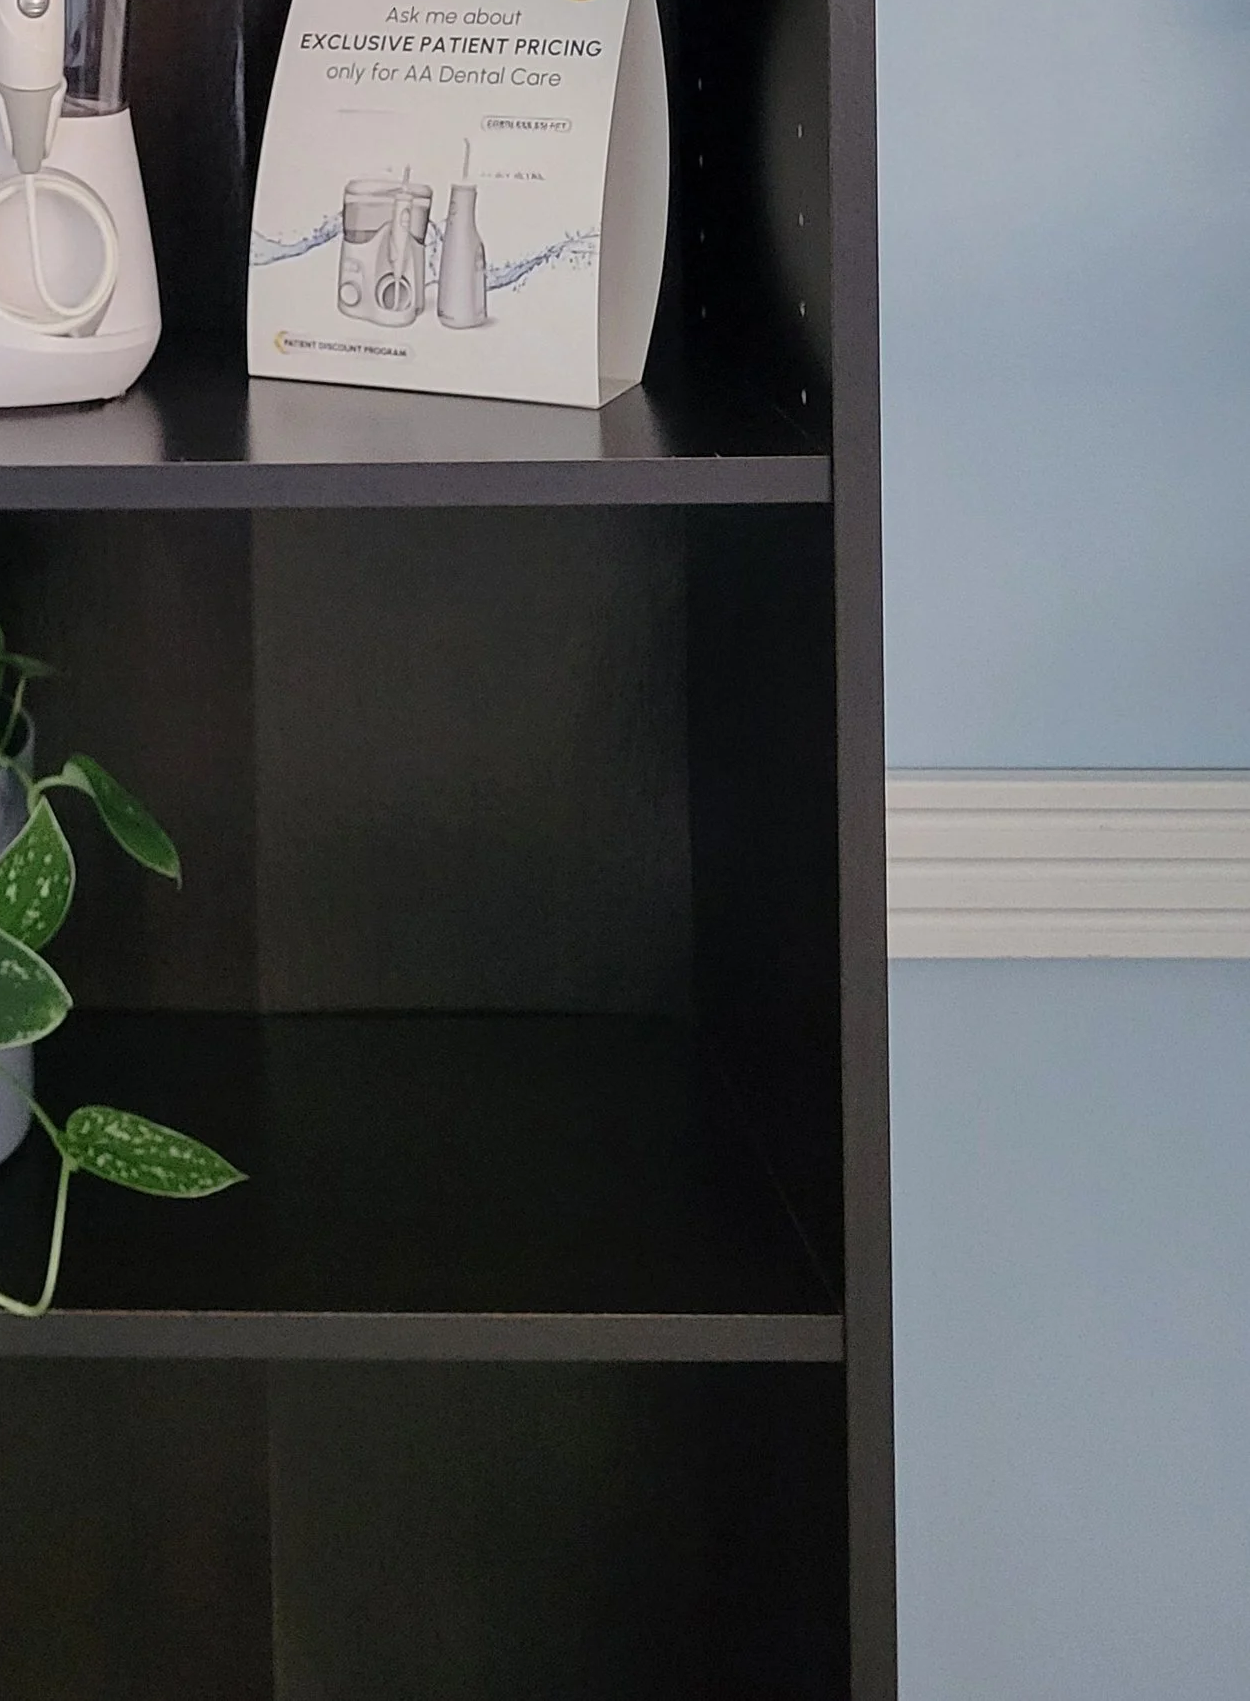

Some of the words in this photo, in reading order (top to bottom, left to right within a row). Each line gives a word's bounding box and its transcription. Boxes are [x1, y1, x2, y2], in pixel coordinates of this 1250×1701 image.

[385, 6, 419, 24] Ask
[425, 9, 457, 24] me
[463, 7, 522, 26] about
[299, 33, 415, 52] EXCLUSIVE
[419, 36, 509, 54] PATIENT
[514, 38, 603, 57] PRICING
[326, 62, 366, 85] only
[370, 62, 399, 82] for
[403, 64, 433, 83] AA
[438, 65, 506, 85] Dental
[510, 67, 562, 87] Care
[284, 338, 316, 349] PATIENT
[318, 341, 361, 352] DISCOUNT
[363, 346, 407, 356] PROGRAM
